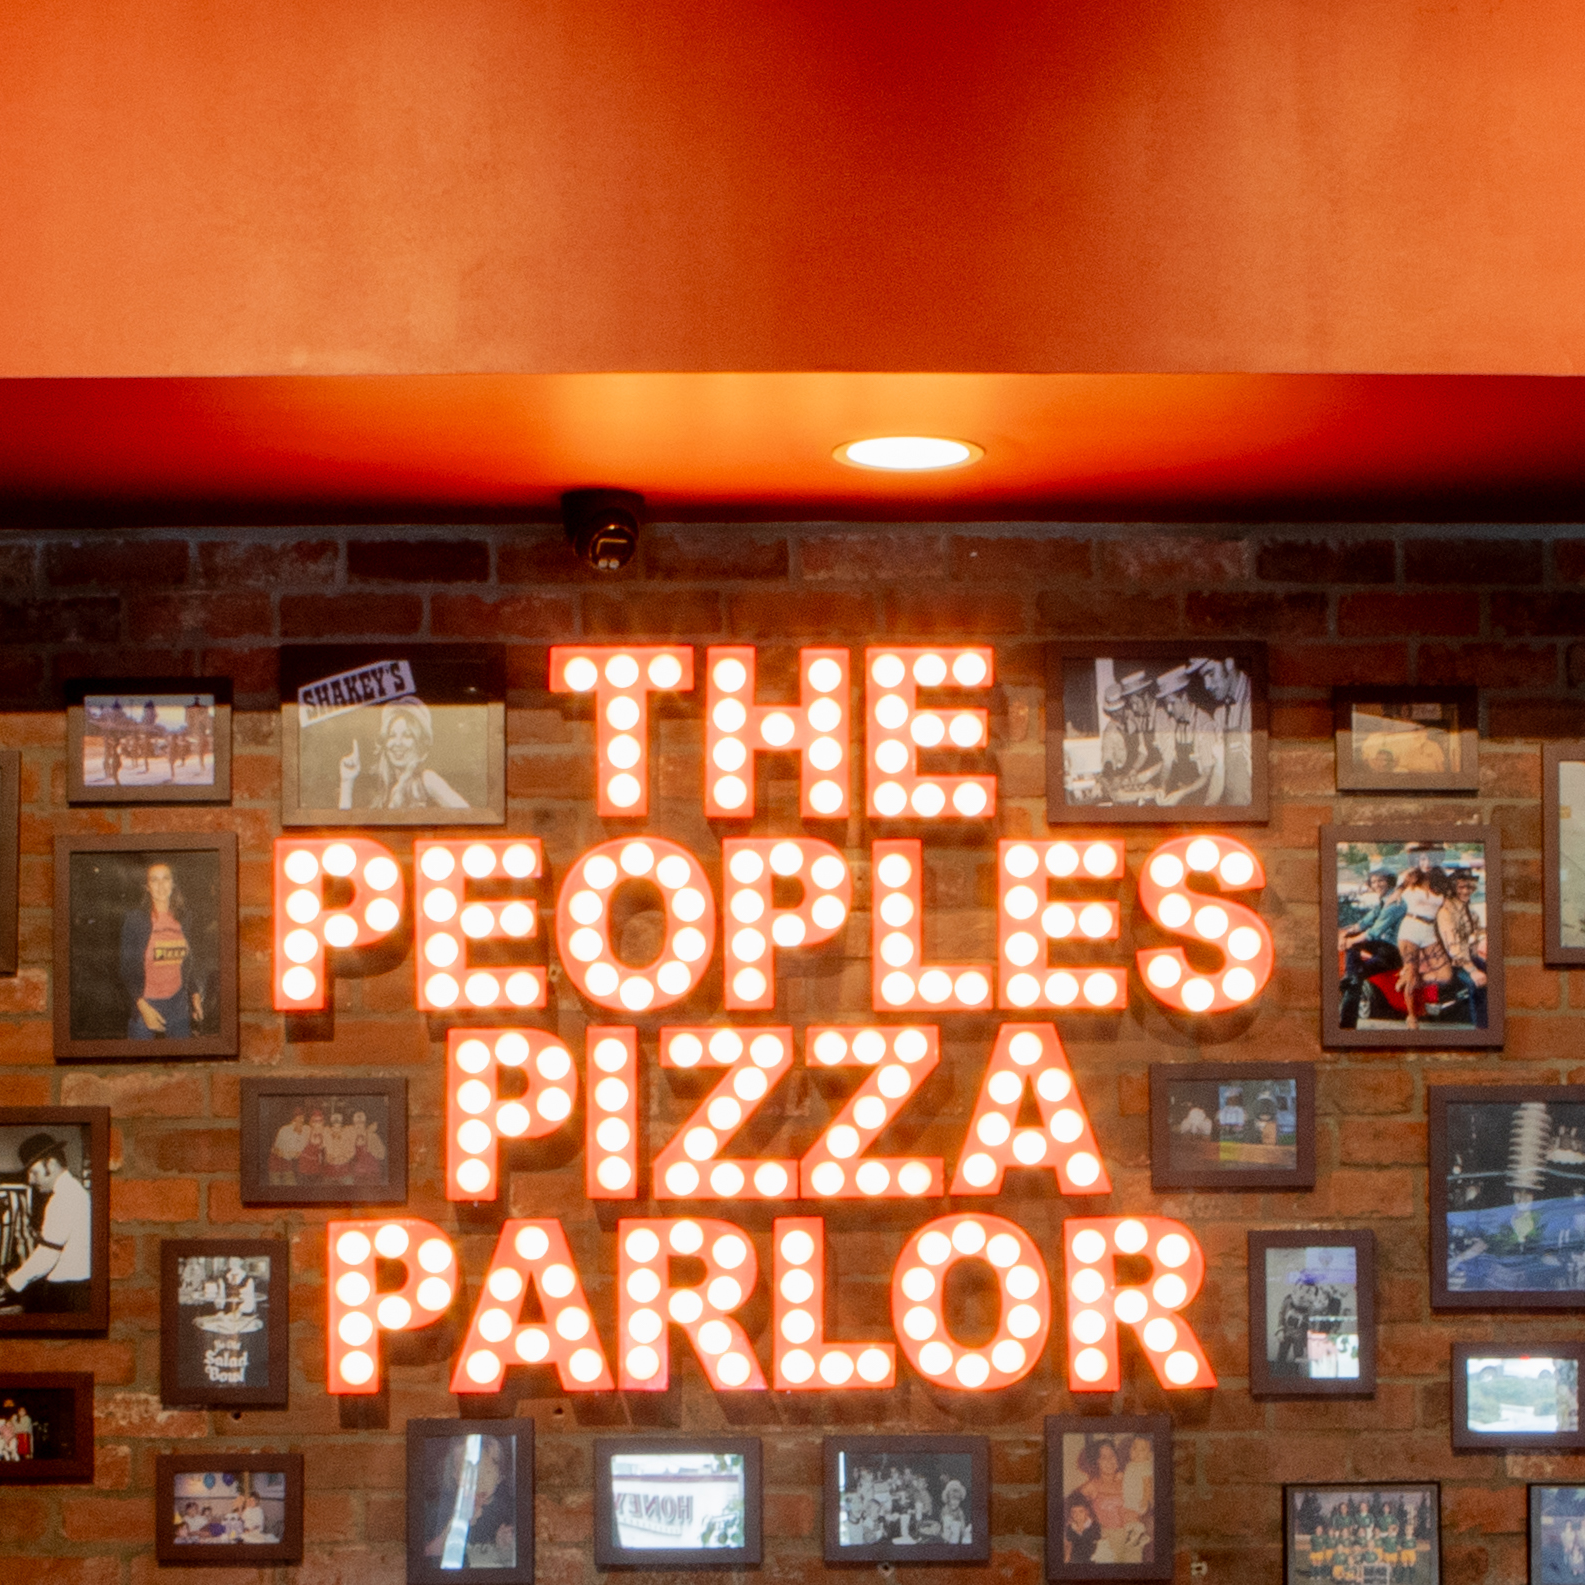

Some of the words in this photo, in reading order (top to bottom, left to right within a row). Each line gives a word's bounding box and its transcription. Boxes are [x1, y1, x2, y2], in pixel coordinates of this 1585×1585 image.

[301, 661, 407, 720] SHAKEY'S
[549, 645, 996, 818] THE
[273, 833, 1275, 1014] PEOPLES
[446, 1021, 1113, 1201] PIZZA
[204, 1349, 249, 1368] Salad
[204, 1365, 246, 1382] Bowl
[327, 1212, 1218, 1394] PARLOR
